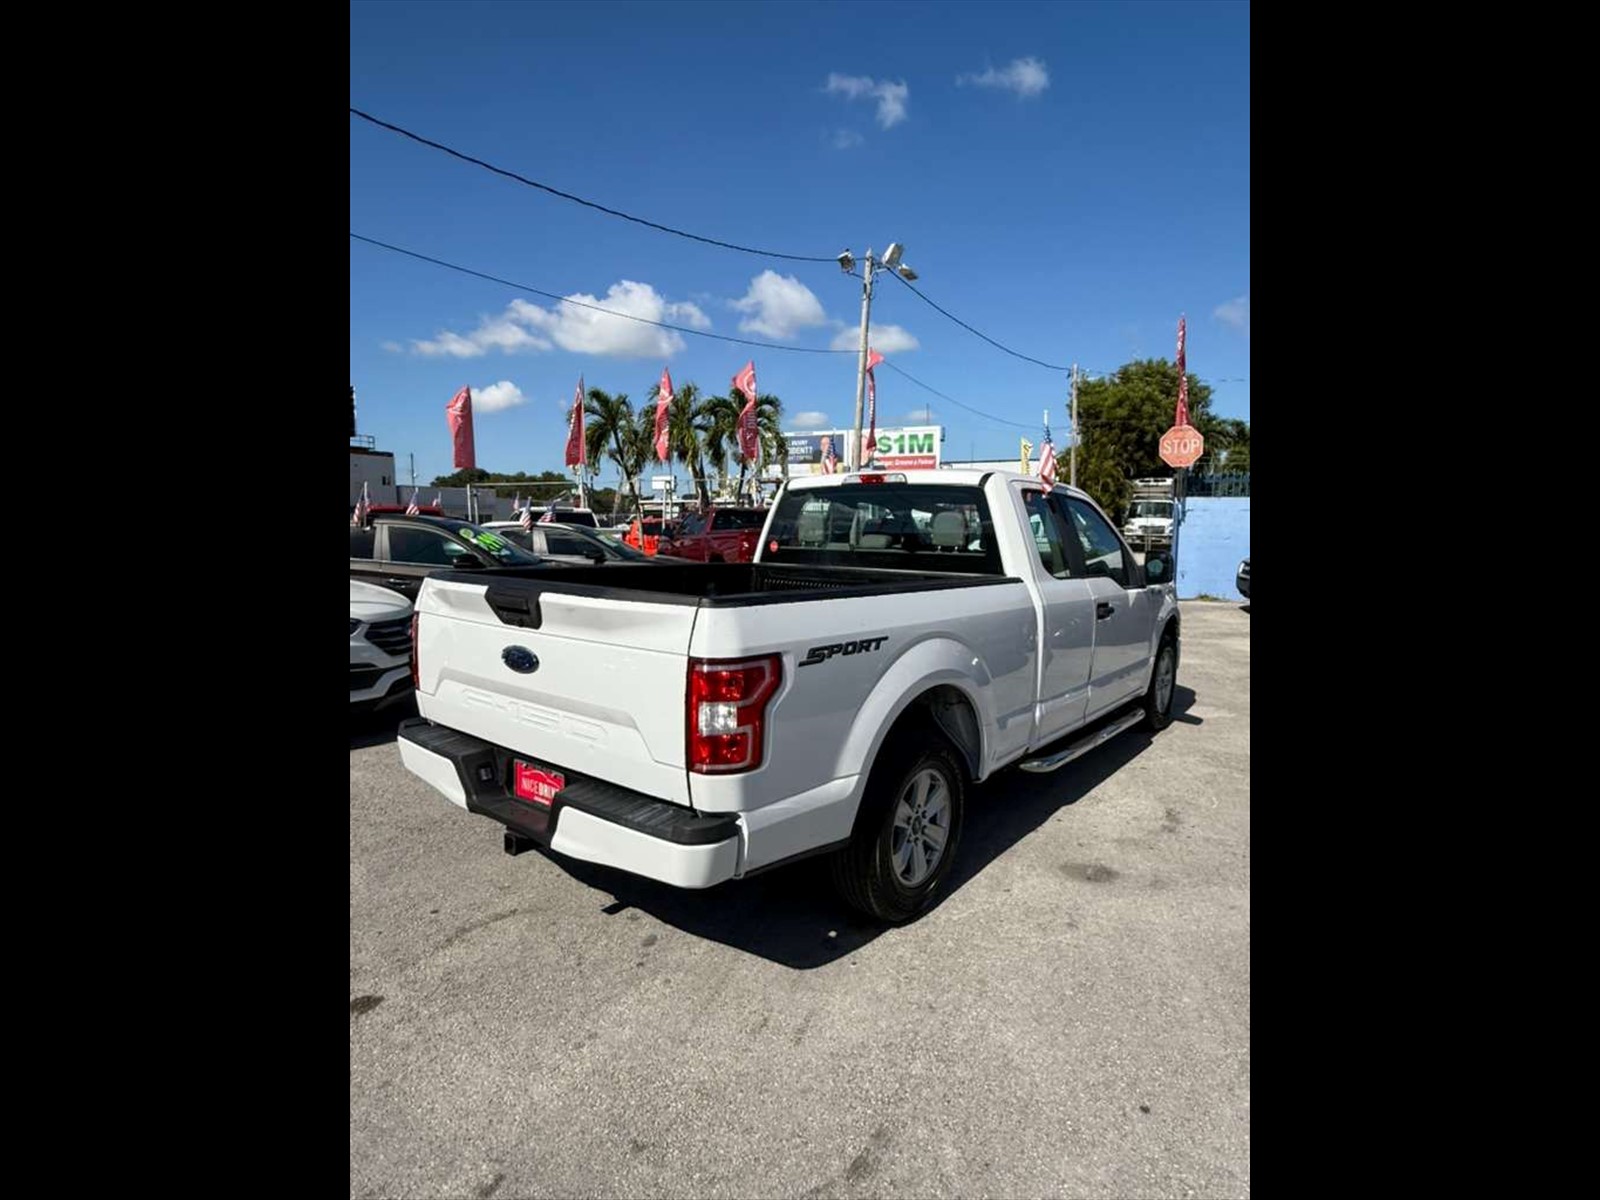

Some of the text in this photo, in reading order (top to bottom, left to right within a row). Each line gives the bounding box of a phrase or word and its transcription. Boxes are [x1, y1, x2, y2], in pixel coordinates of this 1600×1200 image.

[877, 433, 934, 454] $1M
[1162, 438, 1200, 455] STOP
[798, 636, 889, 668] SPORT
